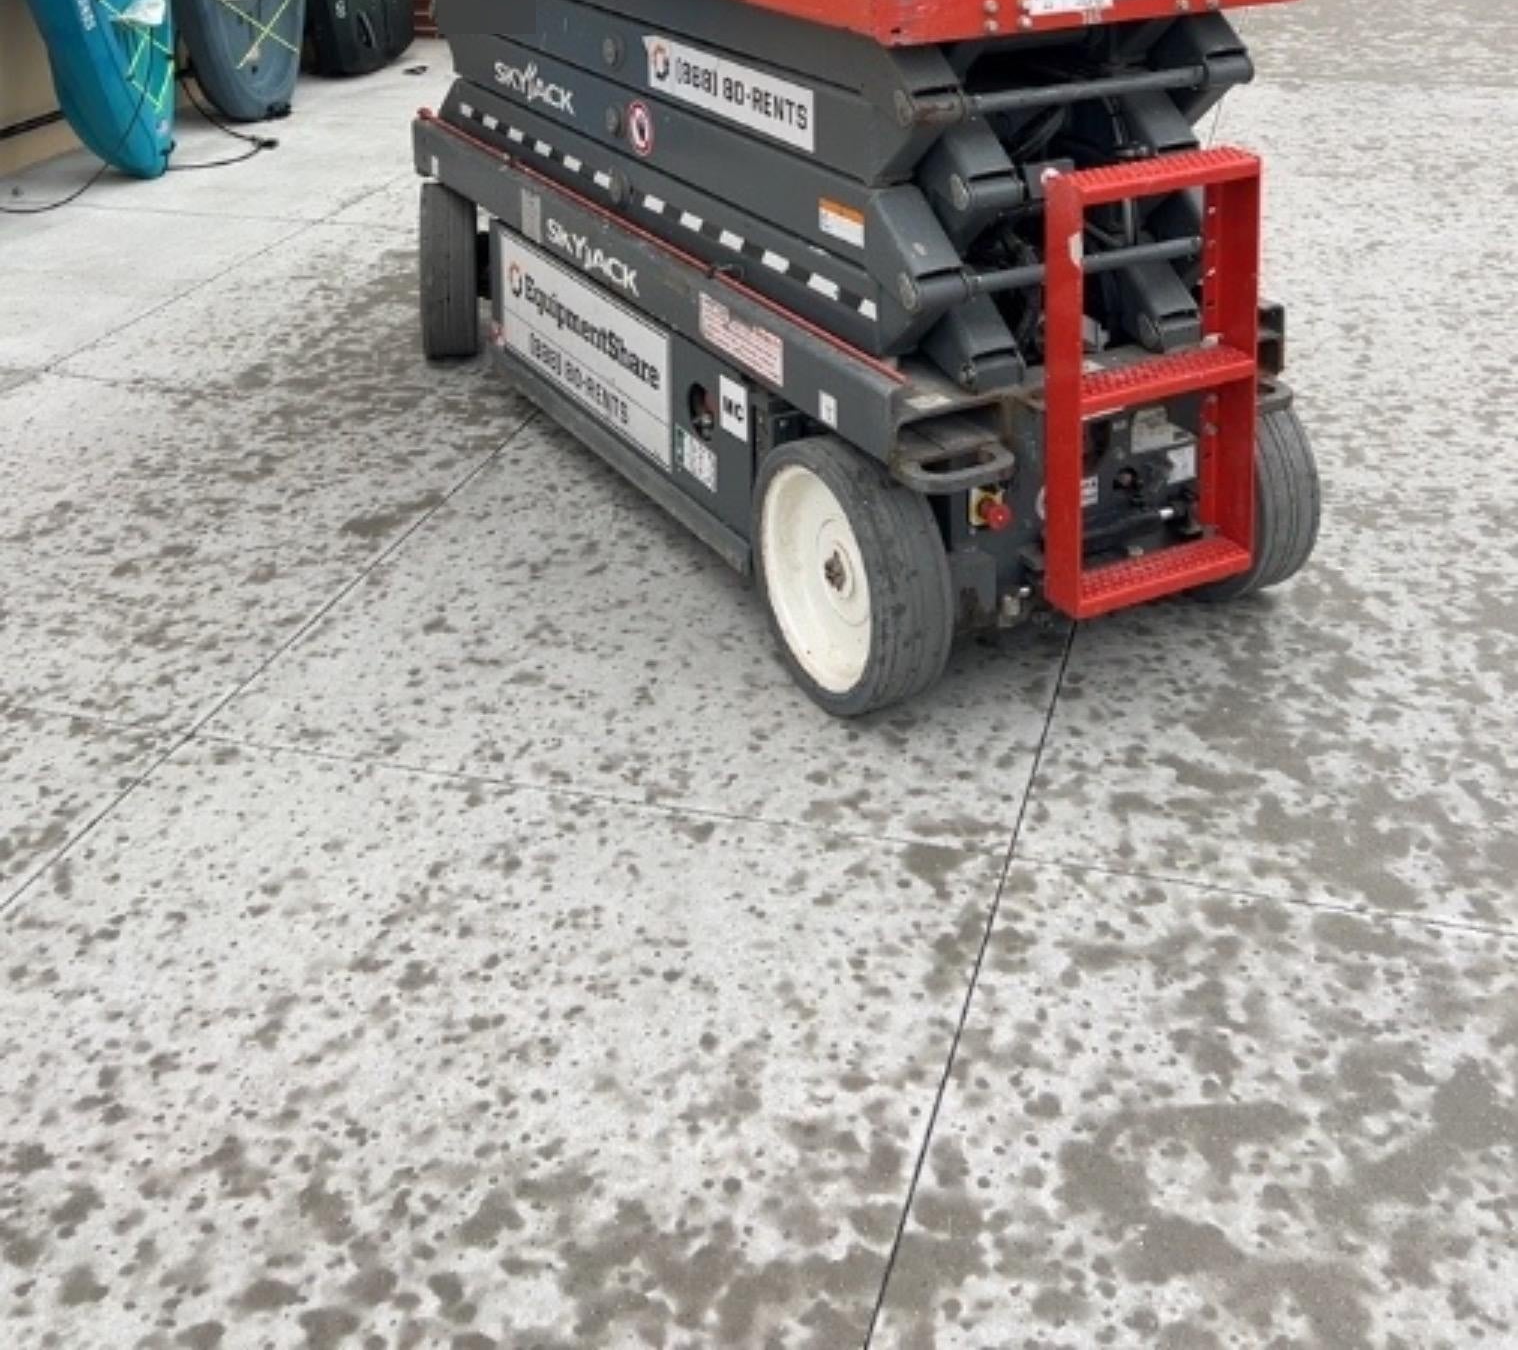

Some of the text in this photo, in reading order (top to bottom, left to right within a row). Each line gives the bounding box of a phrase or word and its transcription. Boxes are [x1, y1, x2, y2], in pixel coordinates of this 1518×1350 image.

[495, 61, 575, 117] SKYJACK
[722, 76, 808, 130] 80-RENTS
[547, 217, 640, 298] SKYJACK
[524, 272, 661, 392] EquipmentShare
[563, 358, 629, 425] 80-RENTS
